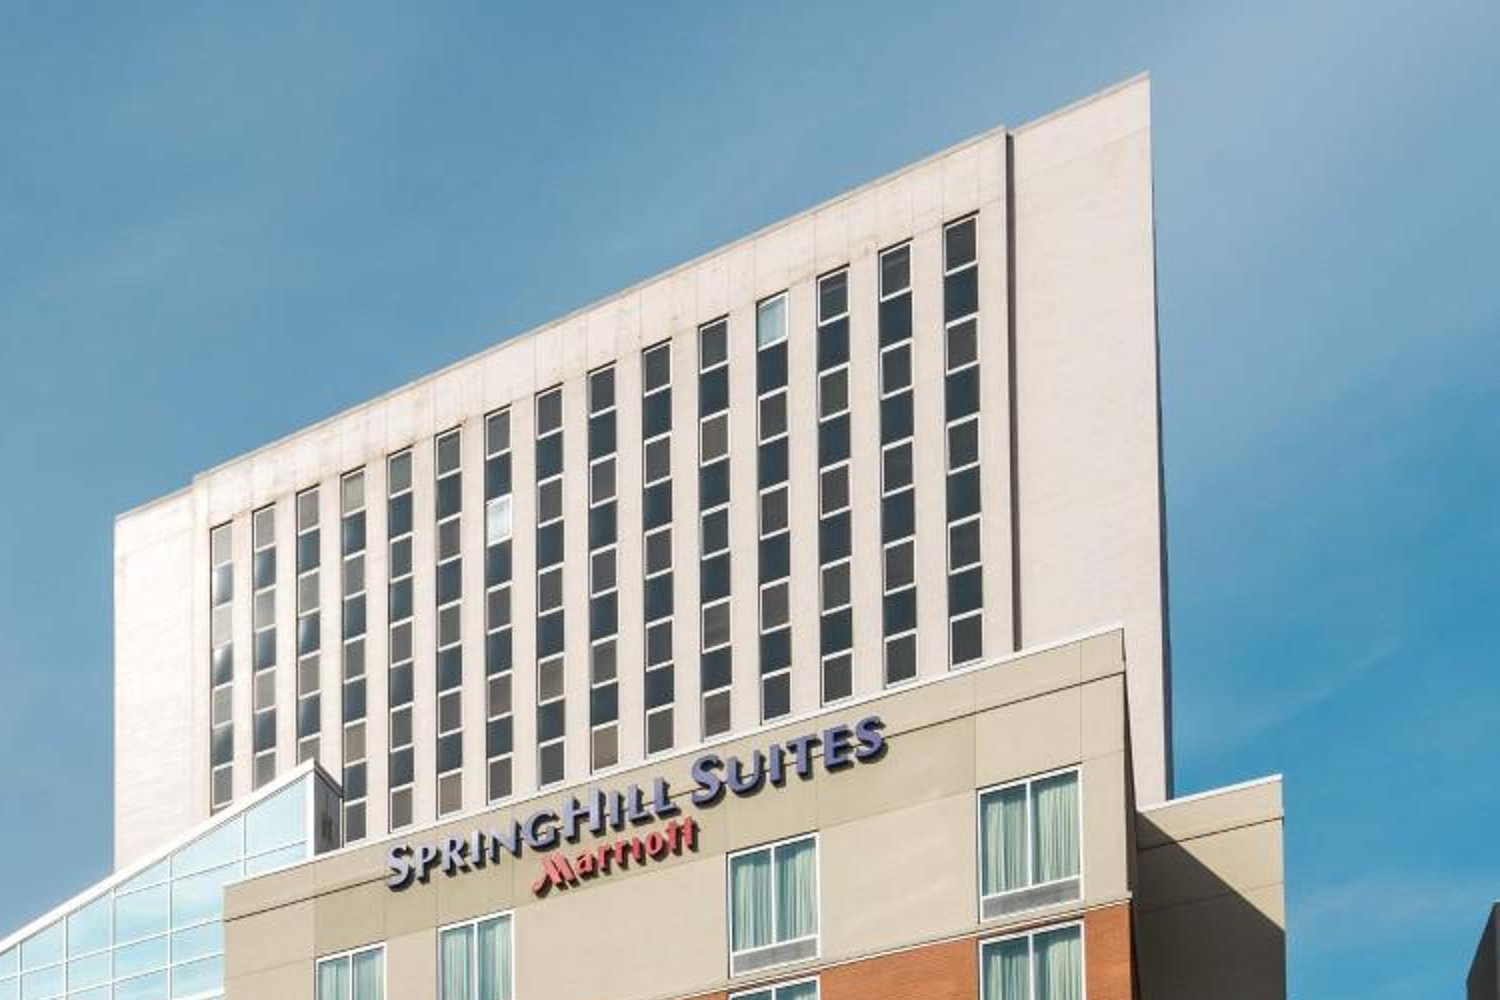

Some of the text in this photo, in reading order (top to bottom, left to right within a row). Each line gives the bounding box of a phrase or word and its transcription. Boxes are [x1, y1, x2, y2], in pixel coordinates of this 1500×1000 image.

[387, 715, 887, 890] SPRINGHILL SUITES
[532, 813, 699, 897] Marriott
